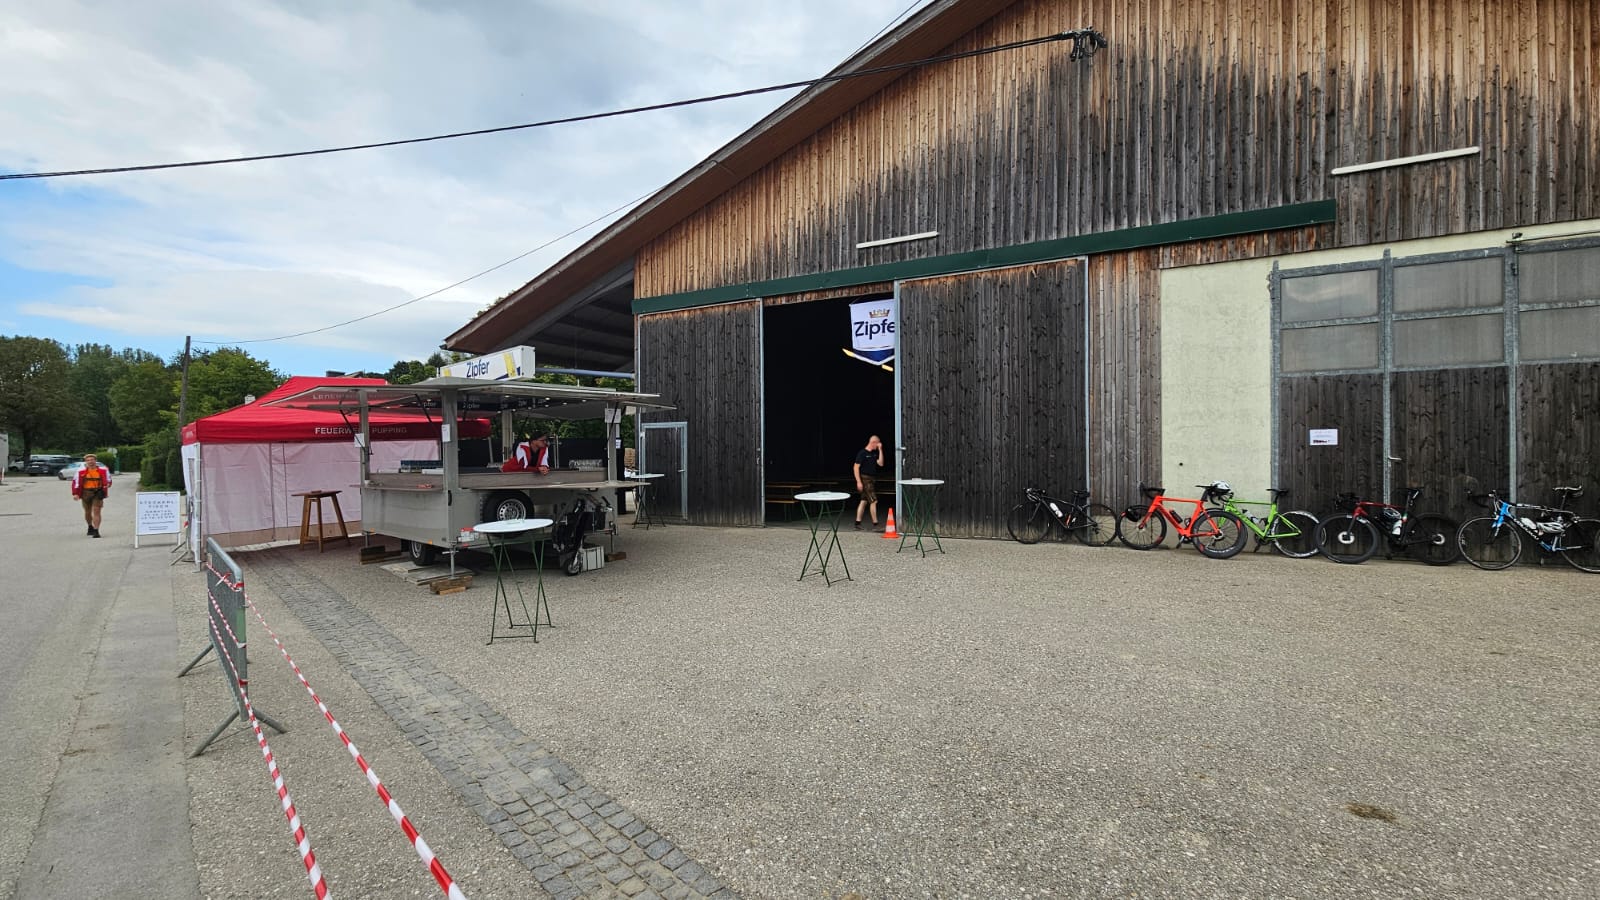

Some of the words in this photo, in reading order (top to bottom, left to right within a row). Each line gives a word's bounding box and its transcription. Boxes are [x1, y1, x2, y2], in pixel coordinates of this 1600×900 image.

[853, 318, 895, 340] Zipfe
[466, 359, 490, 378] Zipfer
[314, 426, 360, 435] FEUERWE
[371, 426, 408, 434] PUPPING
